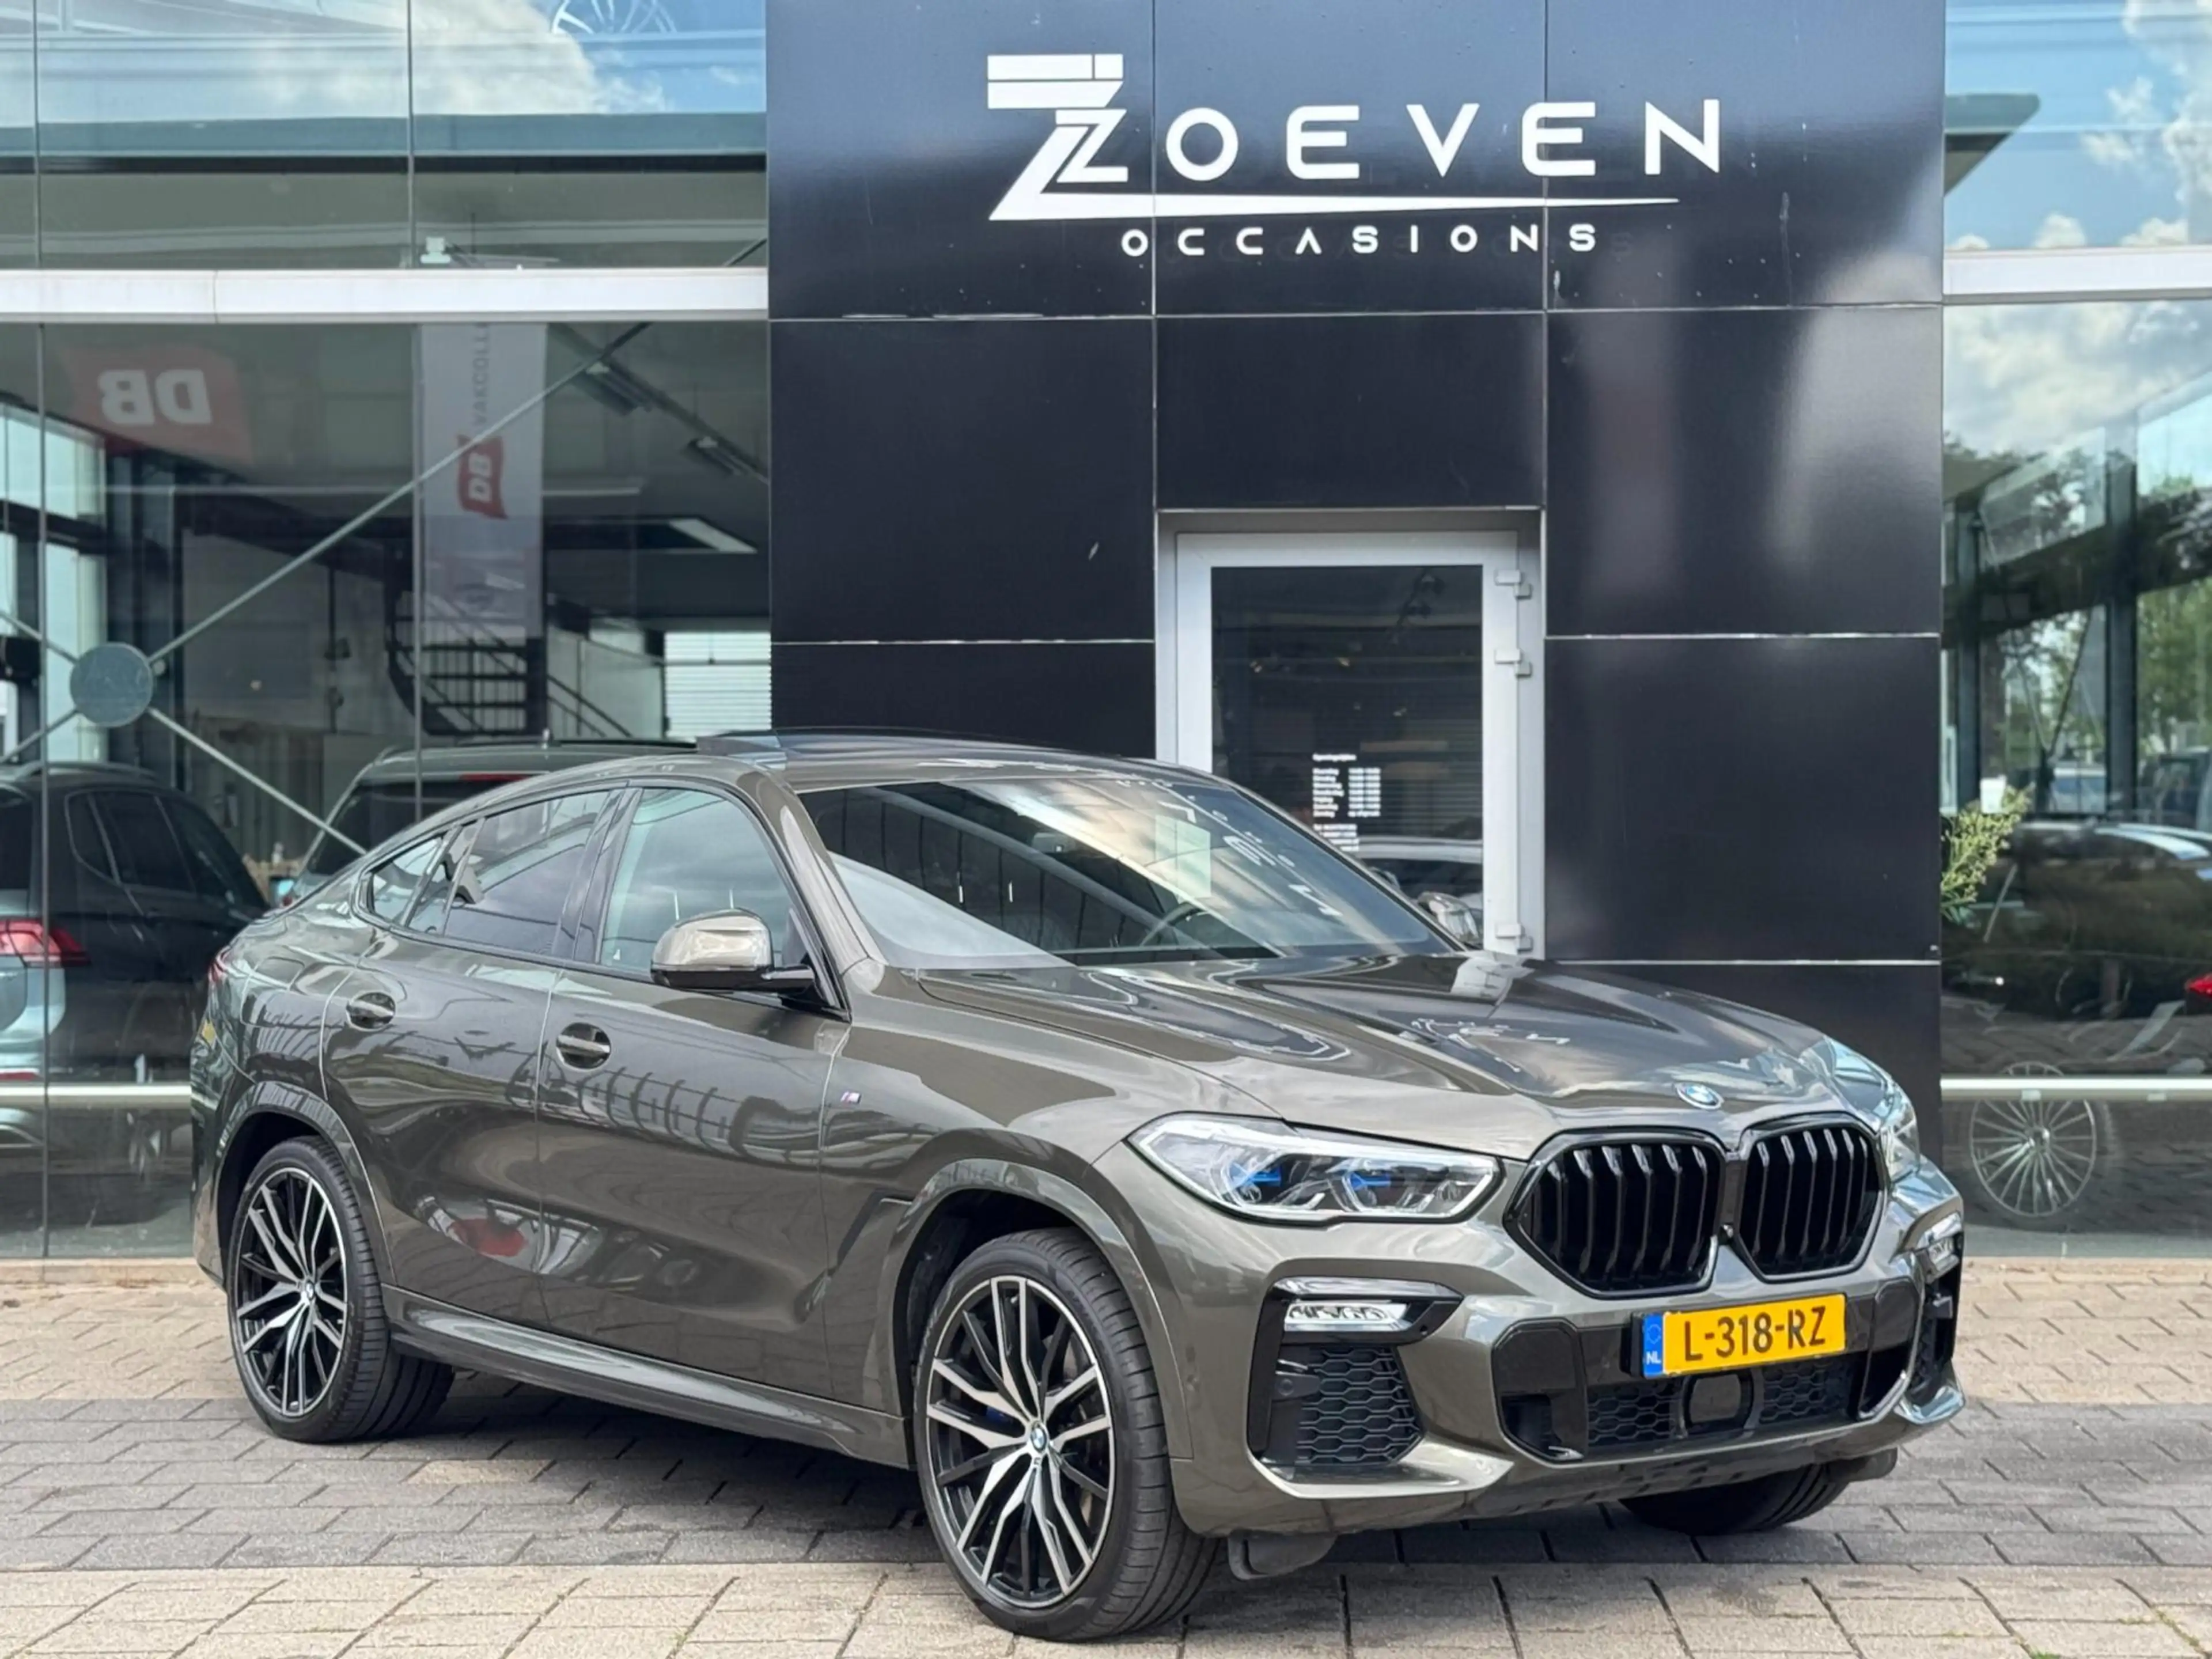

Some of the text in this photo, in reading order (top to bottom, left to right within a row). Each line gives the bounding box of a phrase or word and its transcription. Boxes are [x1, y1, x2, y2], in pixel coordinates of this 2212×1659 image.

[1122, 224, 1596, 256] OCCASIONS
[468, 323, 493, 503] DB VAKCOLL
[1684, 1305, 1827, 1362] L-318-RZ
[1646, 1351, 1661, 1365] NL
